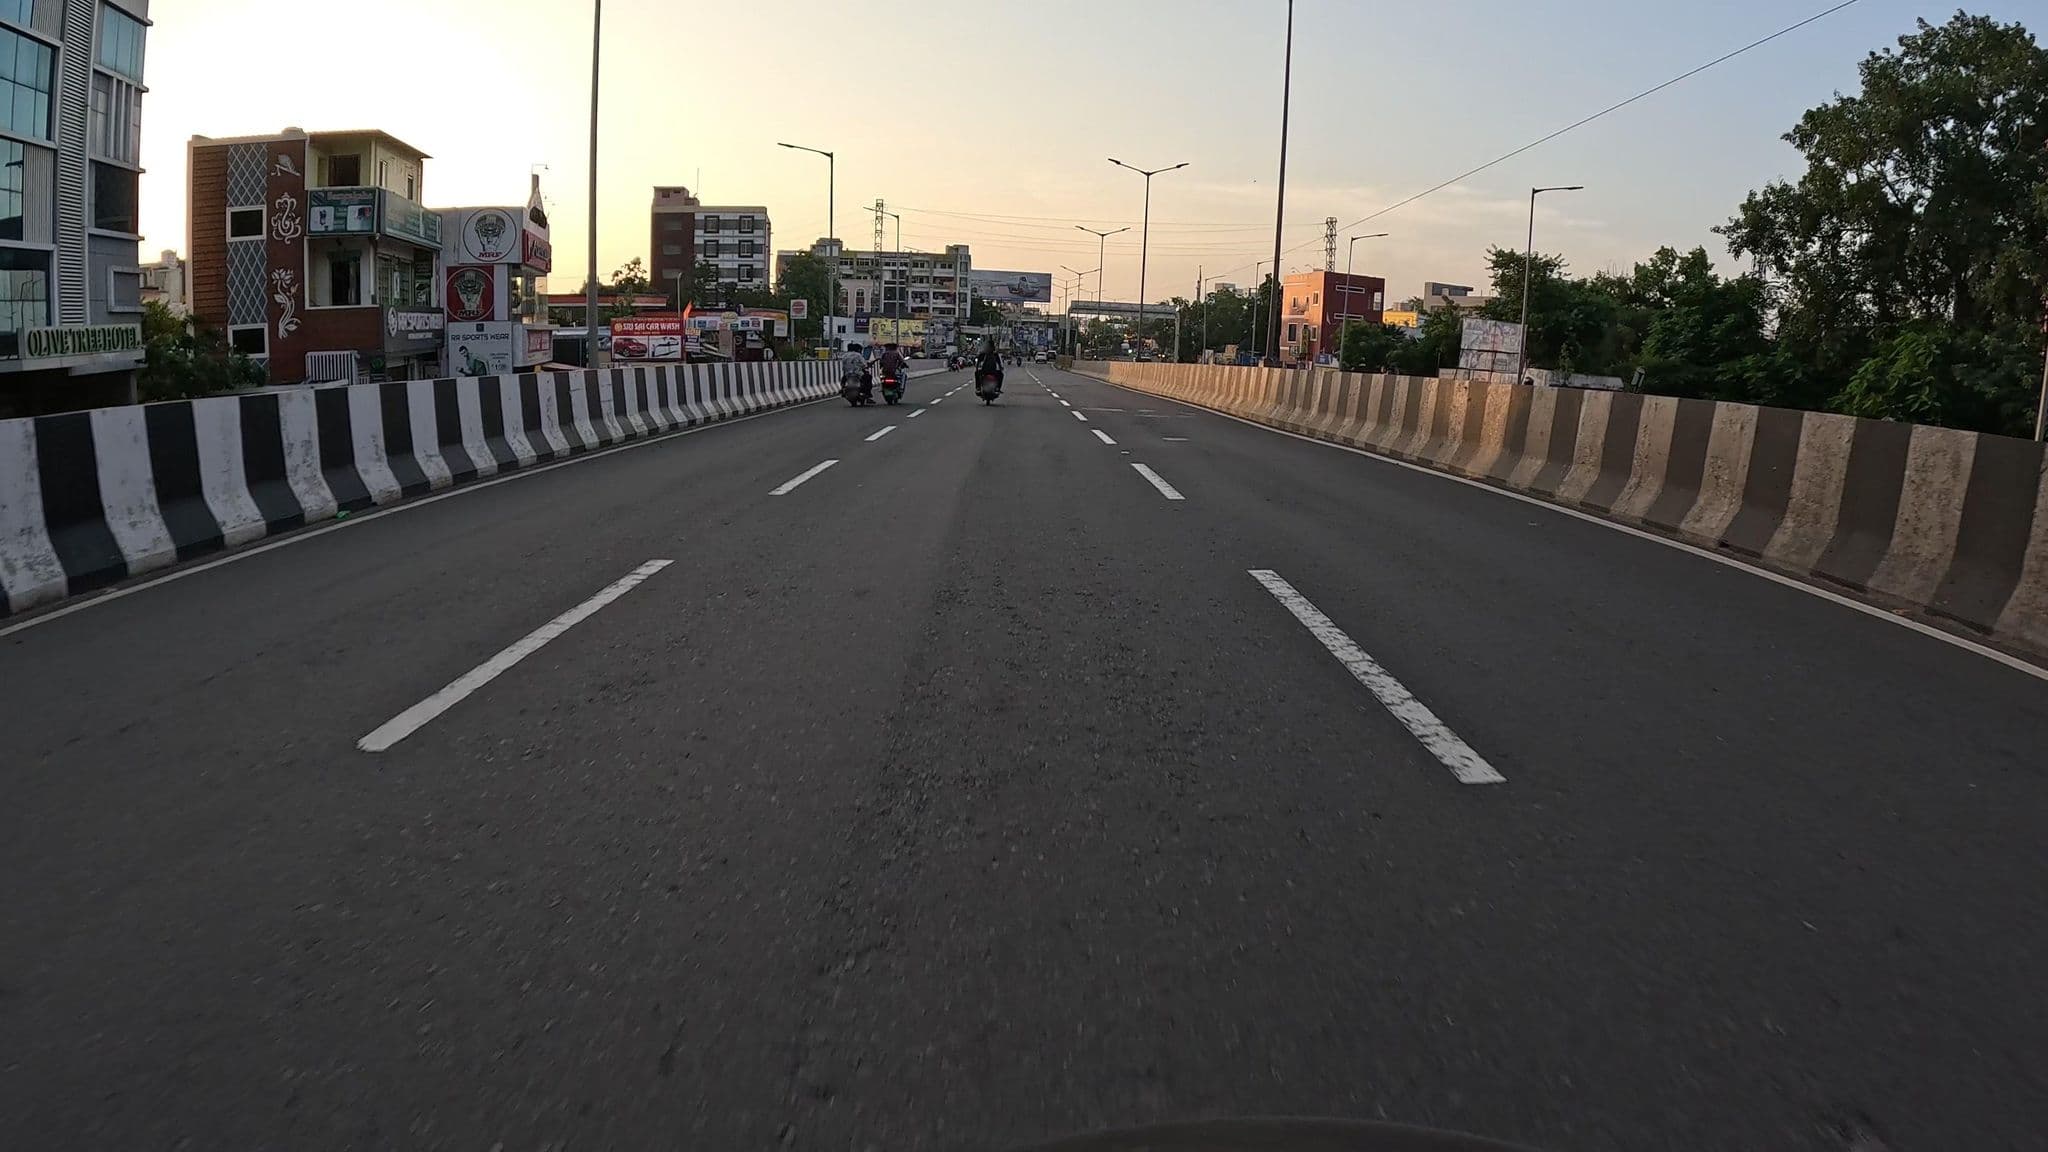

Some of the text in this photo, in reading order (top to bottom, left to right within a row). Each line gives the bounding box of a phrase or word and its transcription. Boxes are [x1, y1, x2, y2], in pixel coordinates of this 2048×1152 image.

[623, 322, 680, 331] SRI SAI CAR WASH
[28, 326, 141, 356] OLIVE TREE HOTEL
[462, 333, 489, 341] SPORTS
